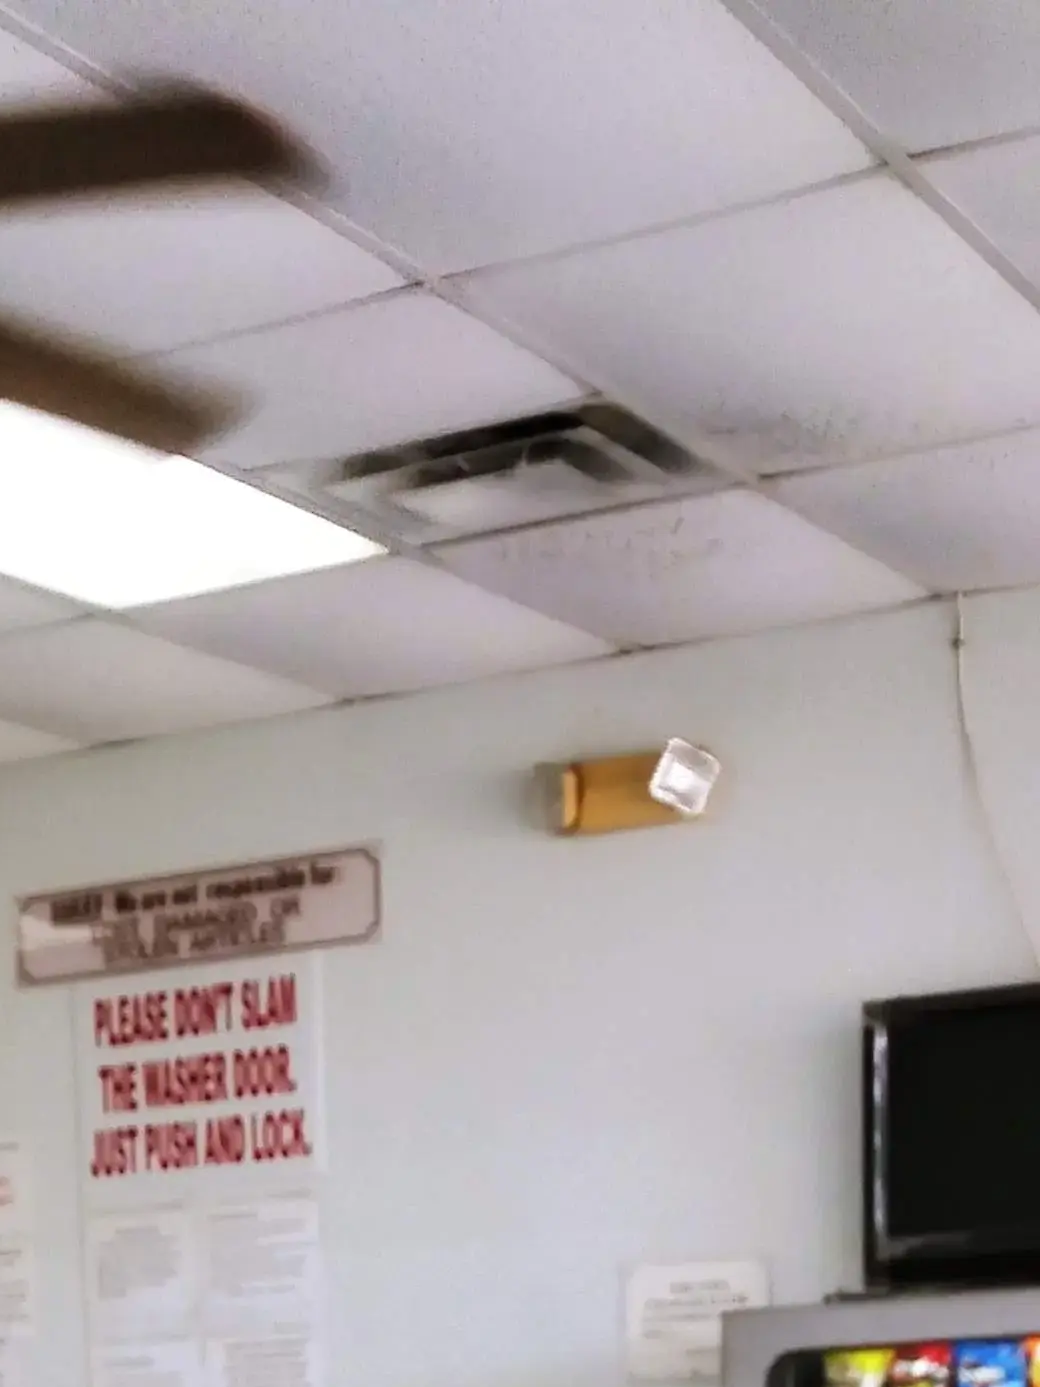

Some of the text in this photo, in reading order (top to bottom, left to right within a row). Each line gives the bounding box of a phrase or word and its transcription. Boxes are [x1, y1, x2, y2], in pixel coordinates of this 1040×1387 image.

[94, 973, 297, 1047] PLEASE DON'T SLAM
[98, 1044, 297, 1113] THE WASHER DOOR.
[90, 1108, 312, 1176] JUST PUSH AND LOCK.
